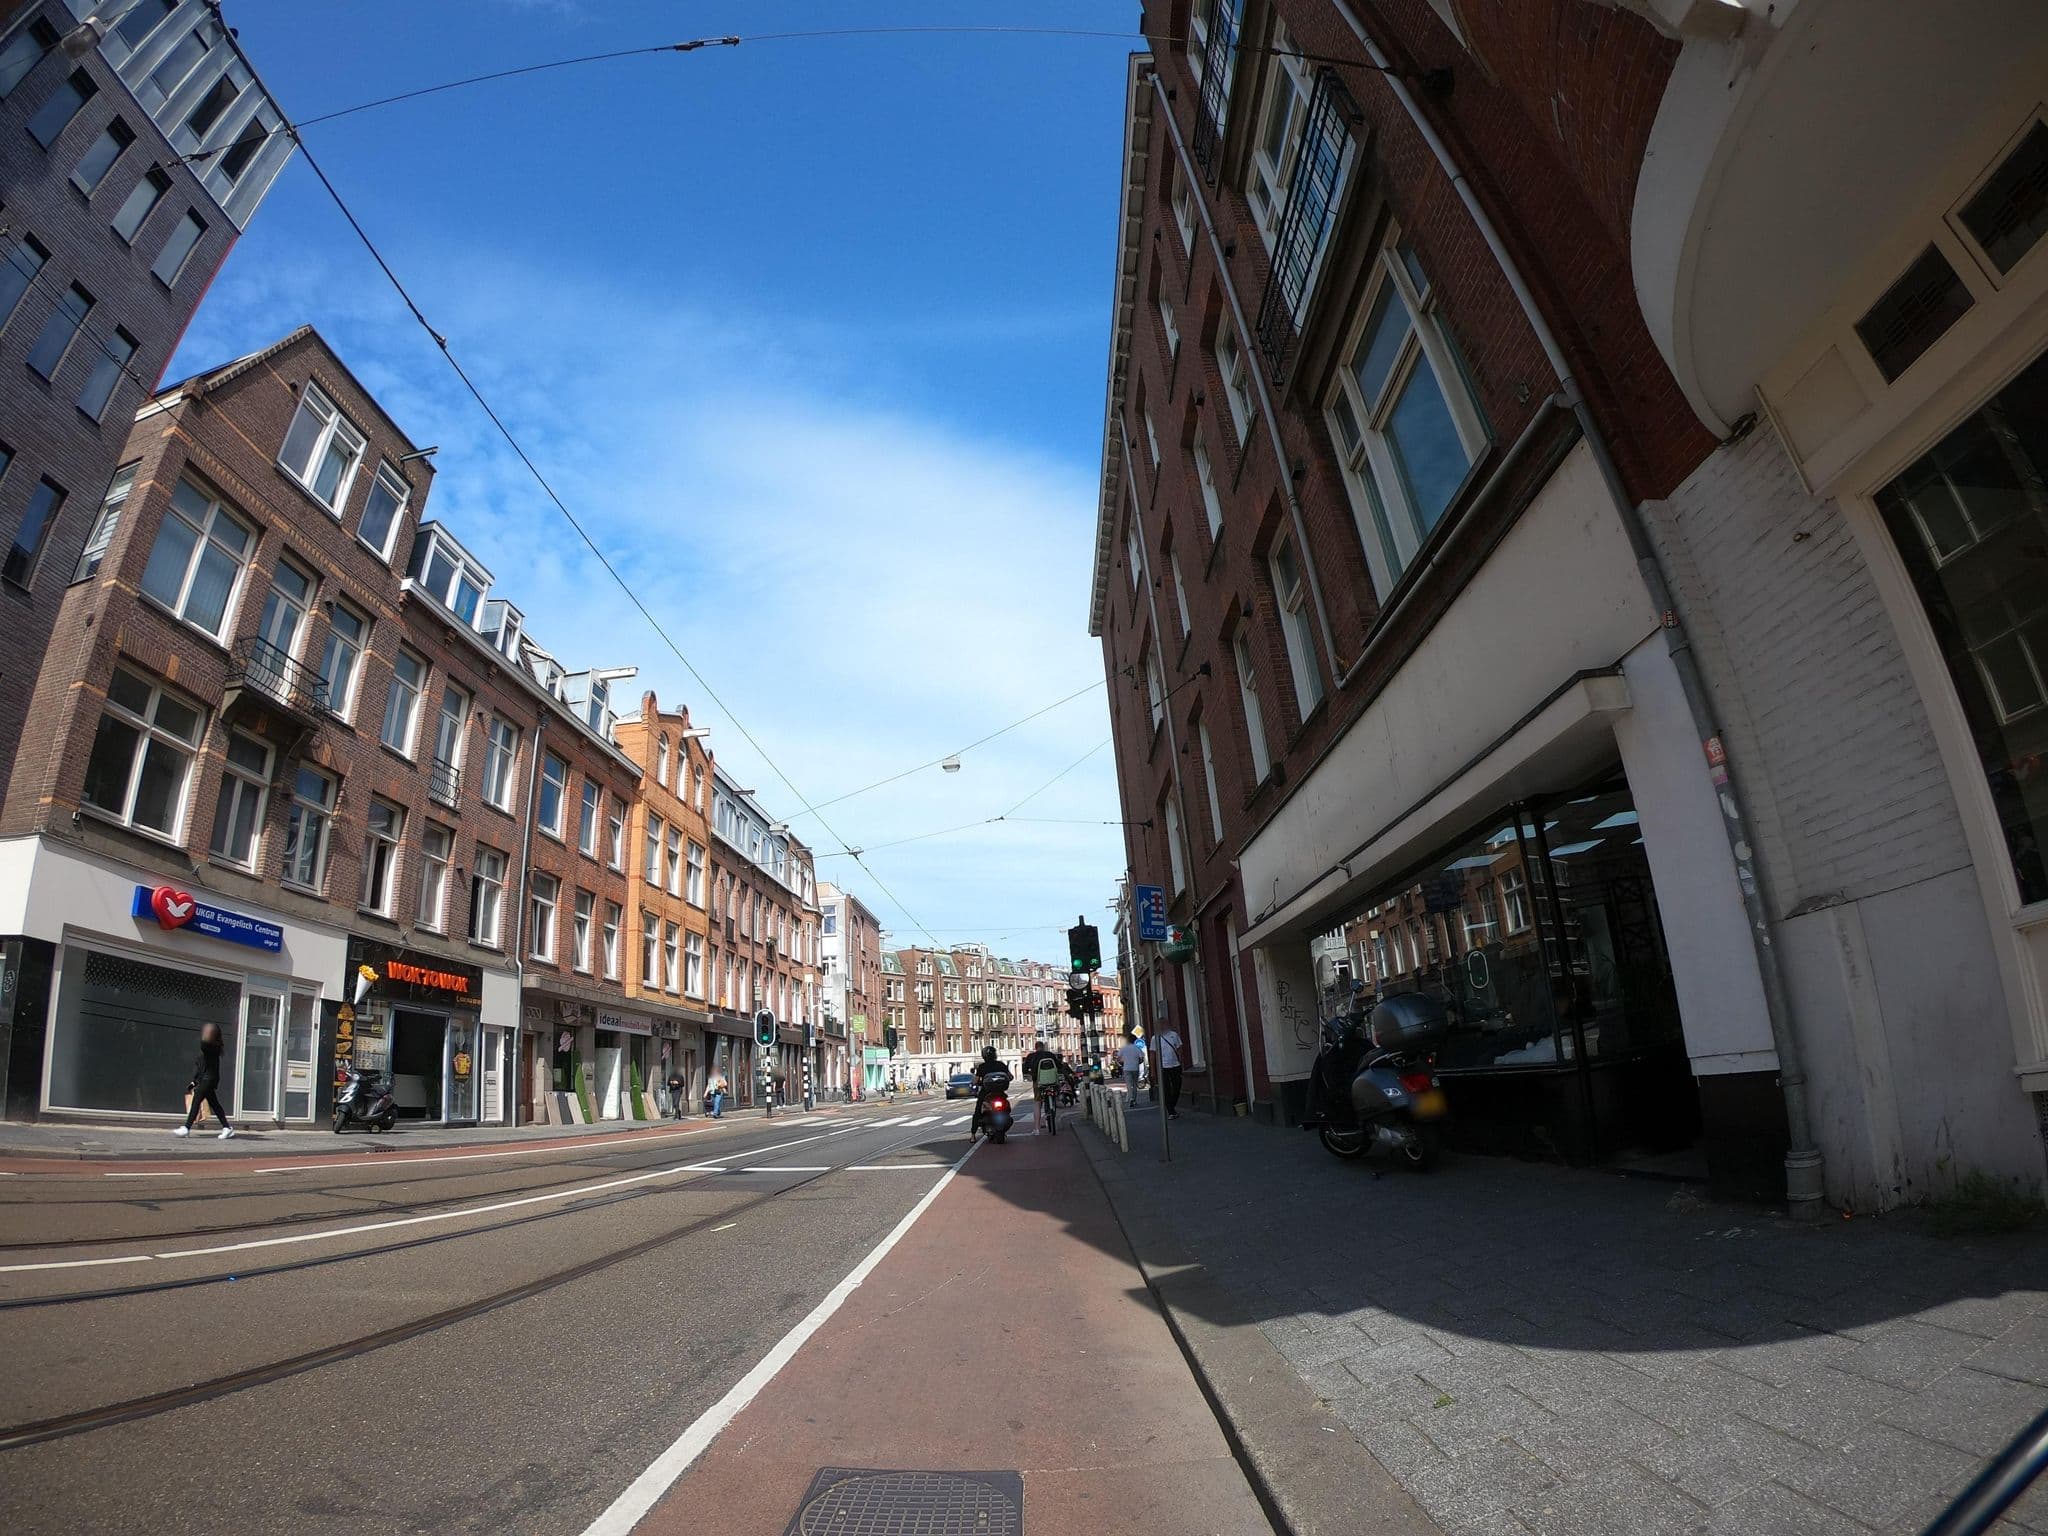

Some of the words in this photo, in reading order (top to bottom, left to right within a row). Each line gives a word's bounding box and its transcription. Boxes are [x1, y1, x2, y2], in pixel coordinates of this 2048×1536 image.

[195, 907, 215, 920] UKGR
[217, 913, 253, 931] Evangelisch
[254, 924, 280, 938] Centrum
[1156, 928, 1165, 936] OP
[388, 961, 421, 984] WOK
[439, 972, 469, 993] WOK
[599, 1012, 622, 1027] ideaal
